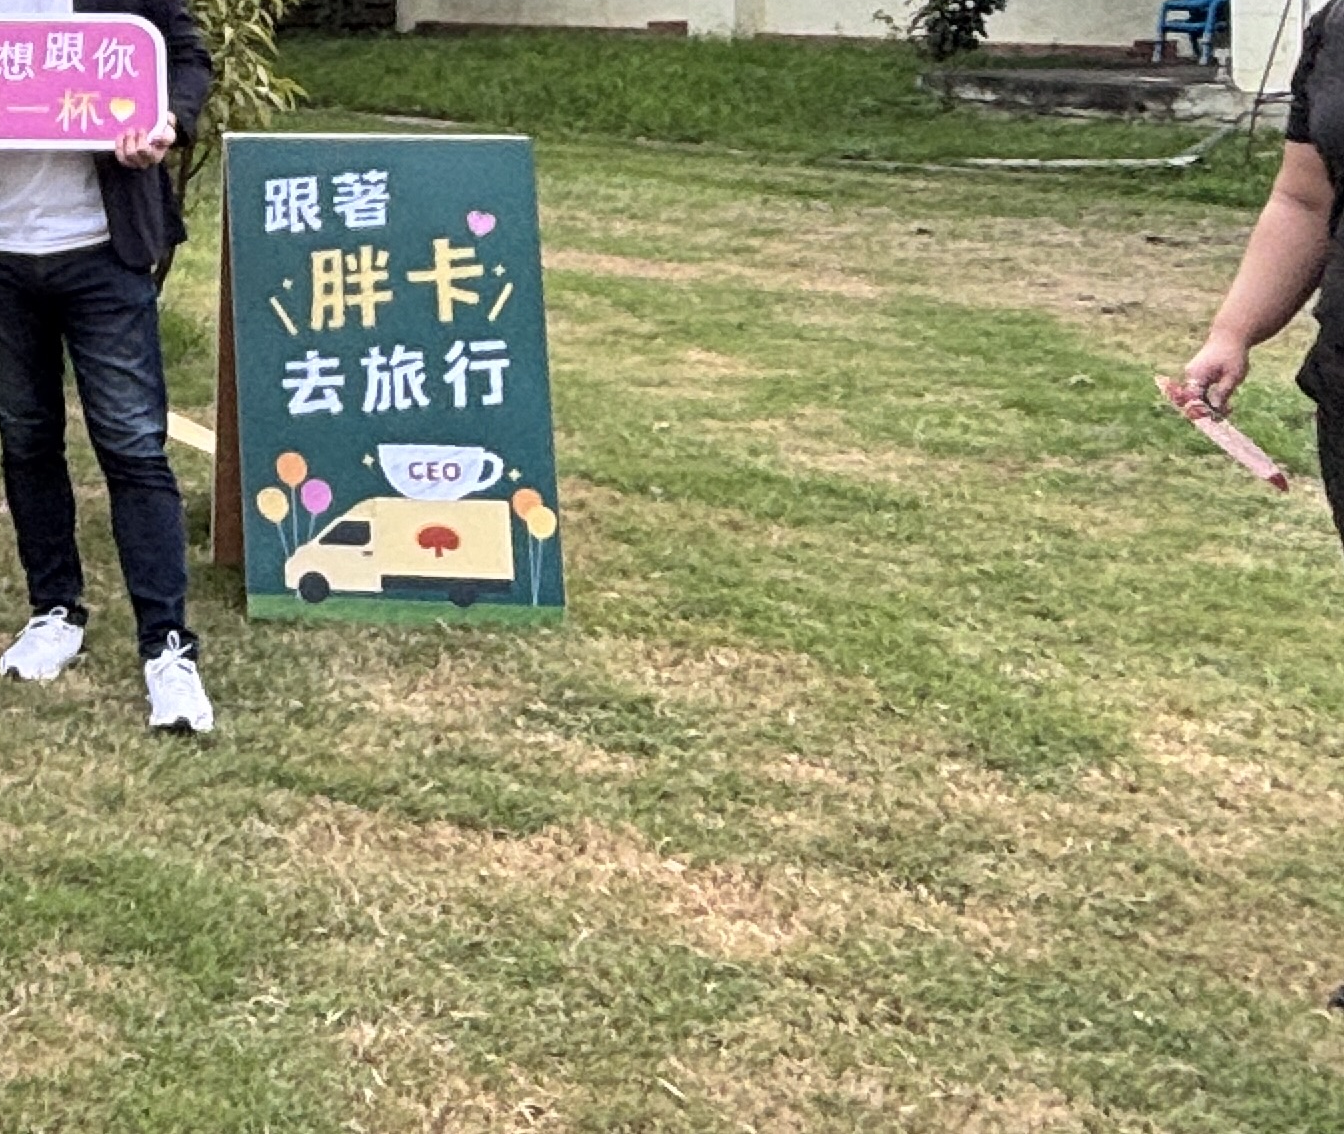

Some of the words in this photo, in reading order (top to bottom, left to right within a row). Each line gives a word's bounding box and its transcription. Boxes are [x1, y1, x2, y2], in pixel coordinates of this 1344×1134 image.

[264, 169, 391, 234] 跟著
[309, 238, 485, 331] 胖卡
[281, 339, 511, 416] 去旅行
[408, 460, 463, 483] CEO
